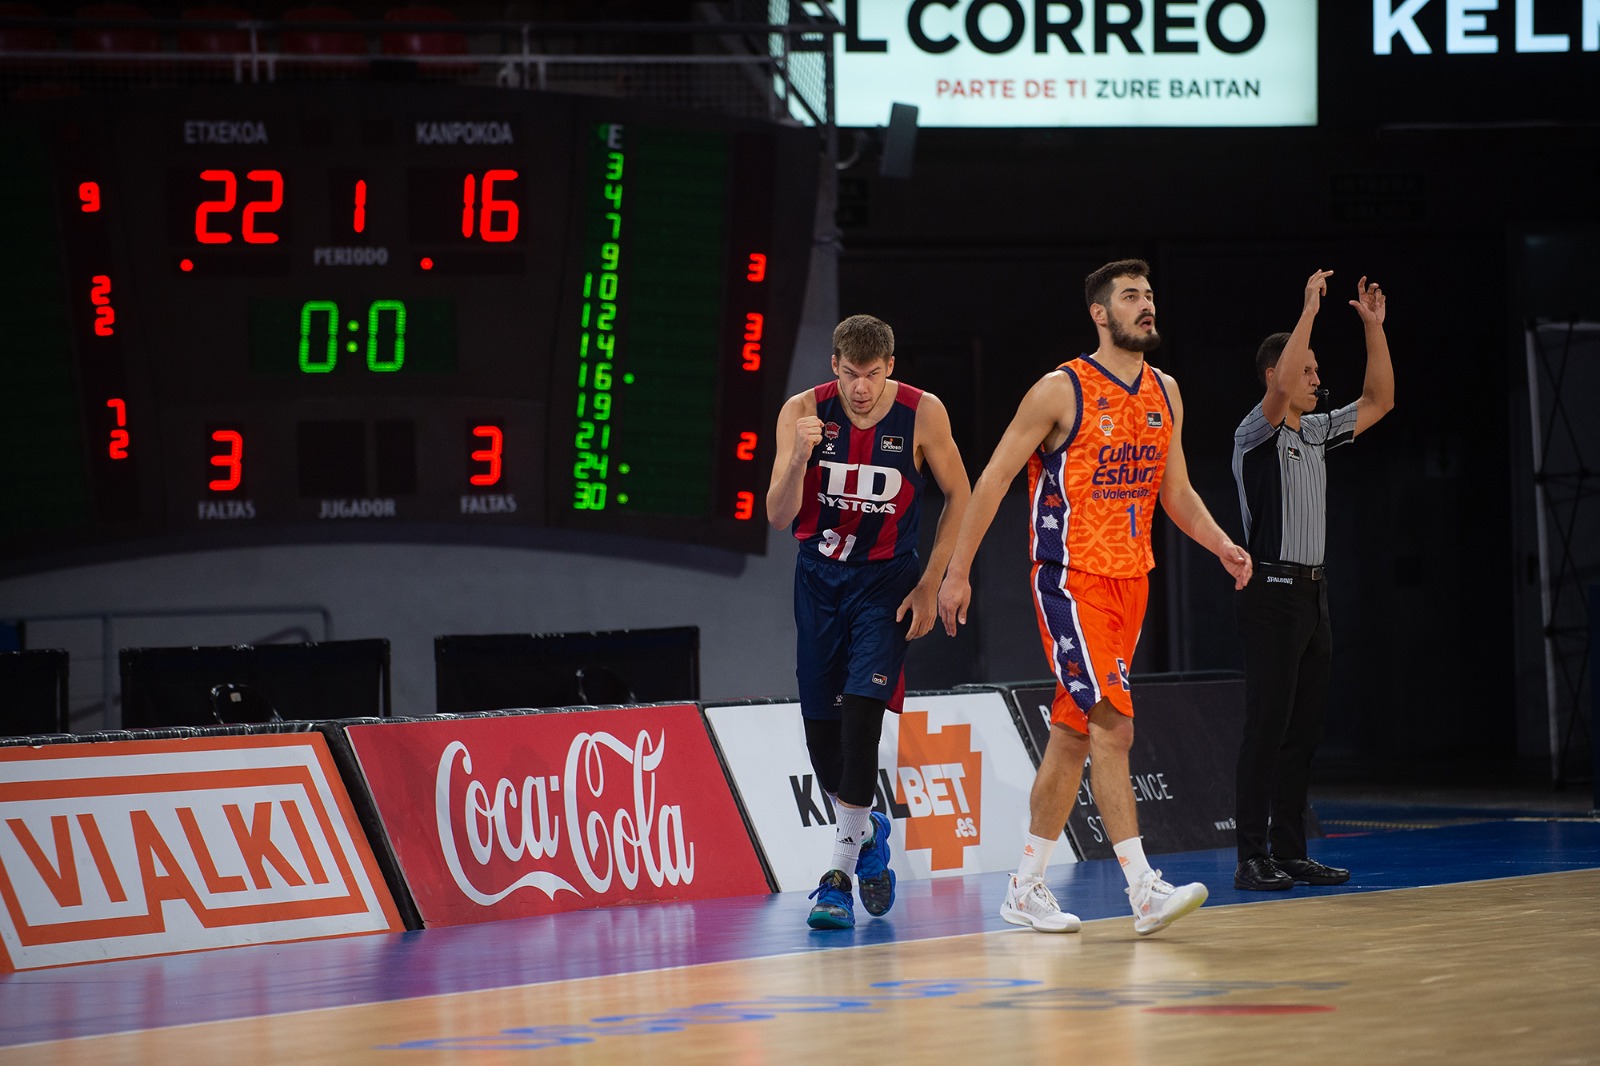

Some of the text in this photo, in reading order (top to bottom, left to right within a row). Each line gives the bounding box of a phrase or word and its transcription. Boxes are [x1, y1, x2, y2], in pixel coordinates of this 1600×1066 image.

[908, 0, 1266, 54] CORREO
[937, 79, 1261, 98] PARTE DE TI ZURE BAITAN
[183, 121, 268, 145] ETXEKOA
[415, 121, 514, 145] KANPOKOA
[605, 152, 624, 181] 3
[78, 181, 101, 213] 9
[195, 169, 284, 245] 22
[353, 179, 367, 233] 1
[461, 169, 520, 243] 16
[604, 183, 623, 210] 4
[605, 212, 622, 240] 7
[314, 246, 389, 267] PERIODO
[601, 242, 620, 271] 9
[747, 253, 767, 283] 3
[583, 272, 618, 300] 10
[581, 302, 617, 331] 12
[299, 299, 407, 374] 0:0
[579, 333, 616, 360] 14
[578, 361, 613, 391] 16
[576, 392, 612, 421] 19
[574, 421, 611, 450] 21
[736, 431, 758, 461] 2
[208, 429, 244, 492] 3
[469, 425, 504, 486] 3
[573, 451, 609, 480] 24
[819, 460, 903, 502] TD
[198, 500, 256, 520] FALTAS
[317, 498, 396, 519] JUGADOR
[460, 493, 518, 515] FALTAS
[573, 481, 608, 511] 30
[734, 491, 755, 521] 3
[817, 492, 897, 515] SYSTEMS
[435, 728, 695, 906] Coca-Cola
[6, 800, 330, 920] VIALKI
